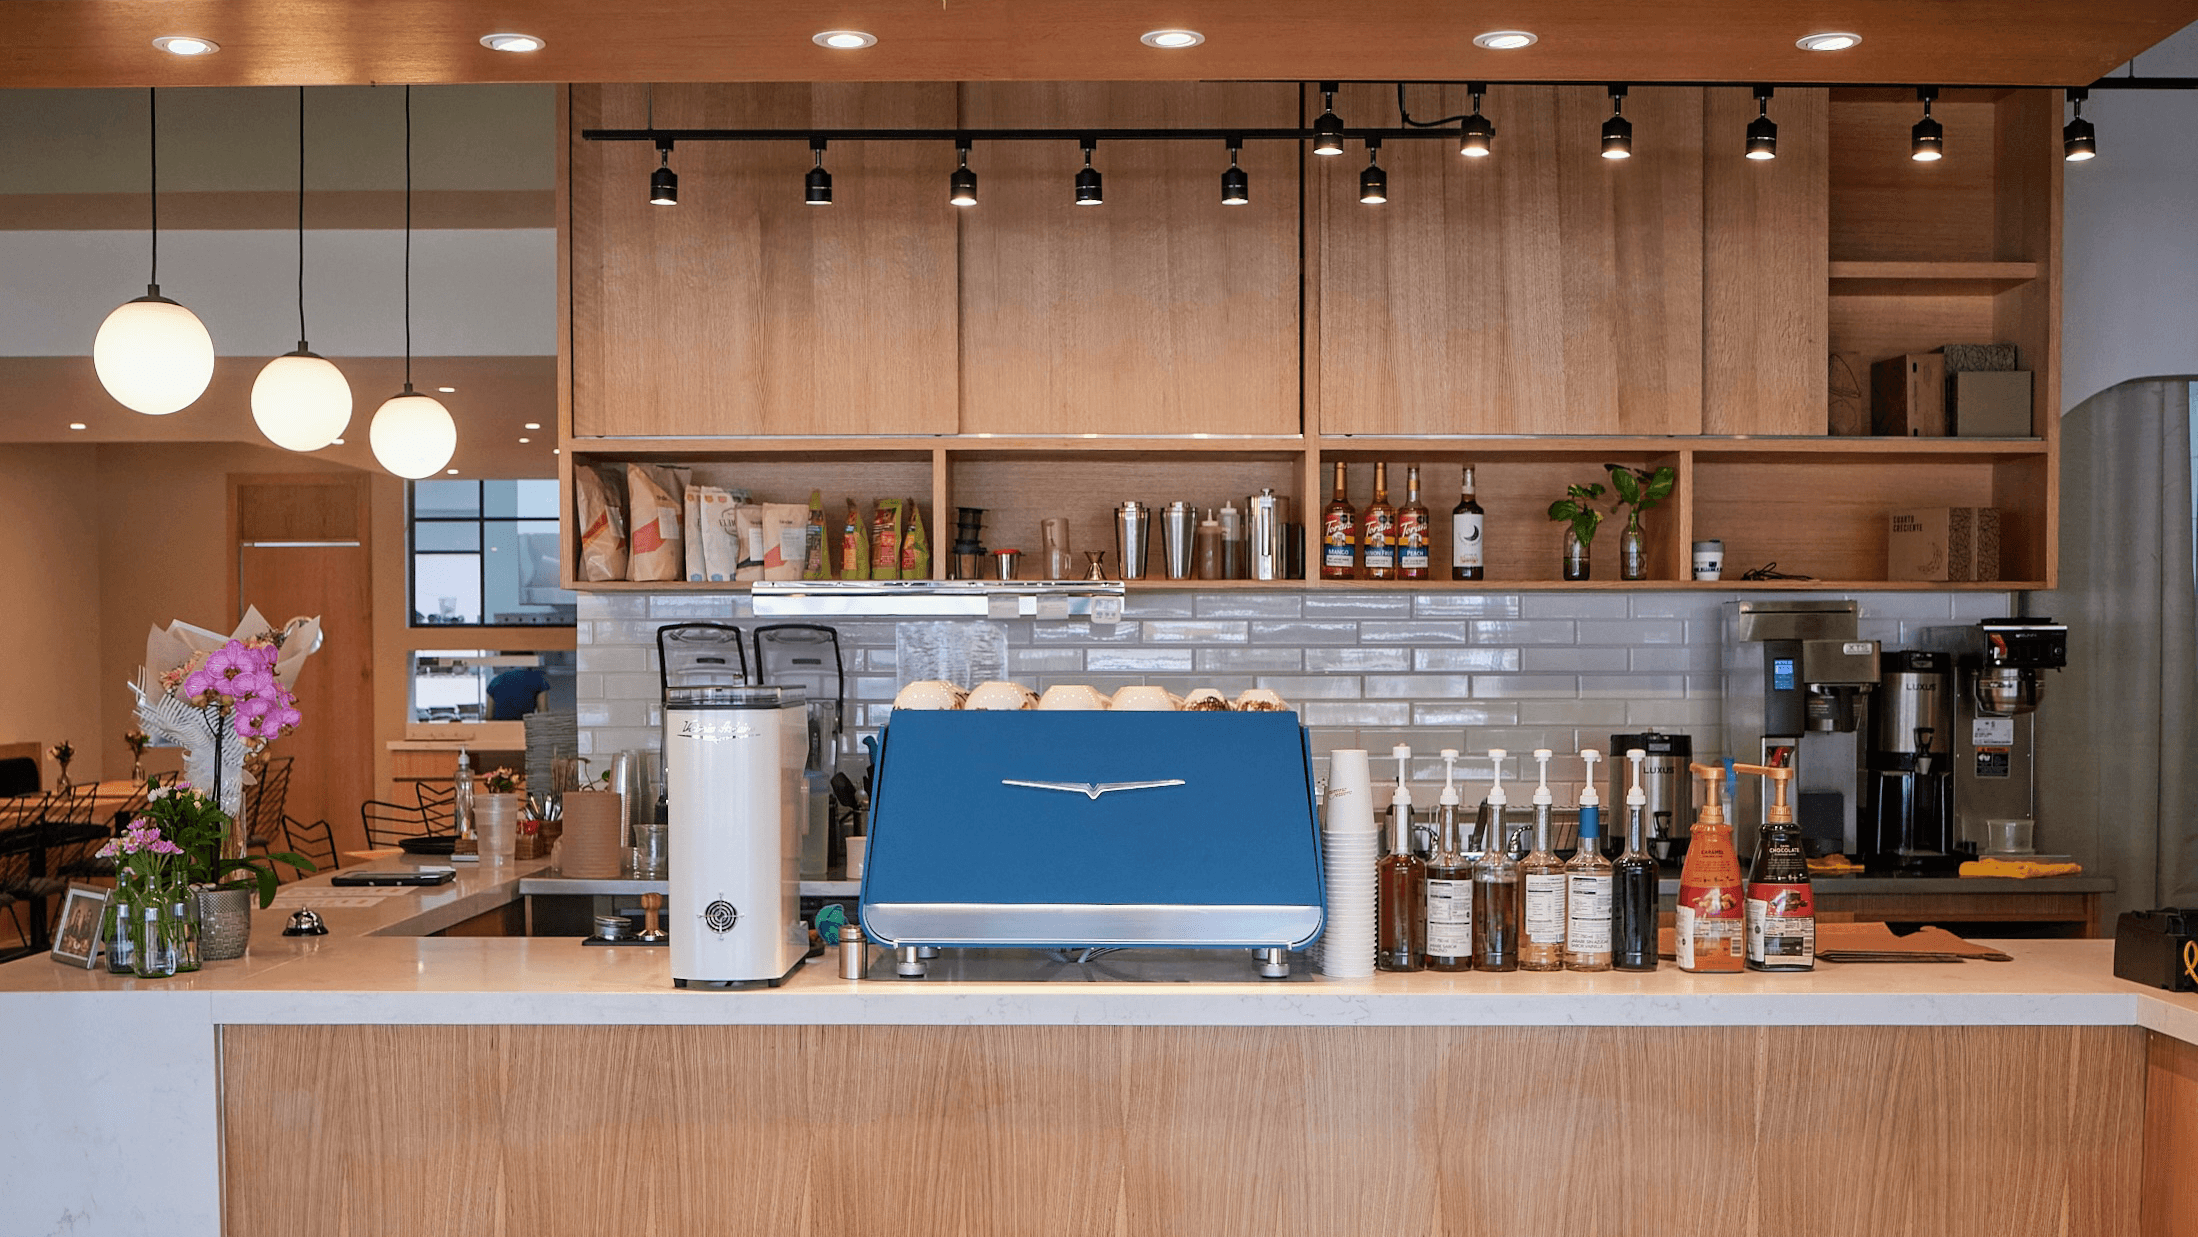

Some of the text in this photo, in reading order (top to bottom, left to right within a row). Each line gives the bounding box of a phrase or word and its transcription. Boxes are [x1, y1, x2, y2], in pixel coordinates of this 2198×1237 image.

[1893, 515, 1915, 524] CUARTO
[1325, 519, 1353, 537] Torani
[1365, 520, 1393, 538] Torani
[1400, 520, 1428, 538] Torani
[1893, 524, 1923, 532] CRECIENTE
[1906, 682, 1937, 691] LUXUS
[1643, 766, 1675, 774] LUXUS
